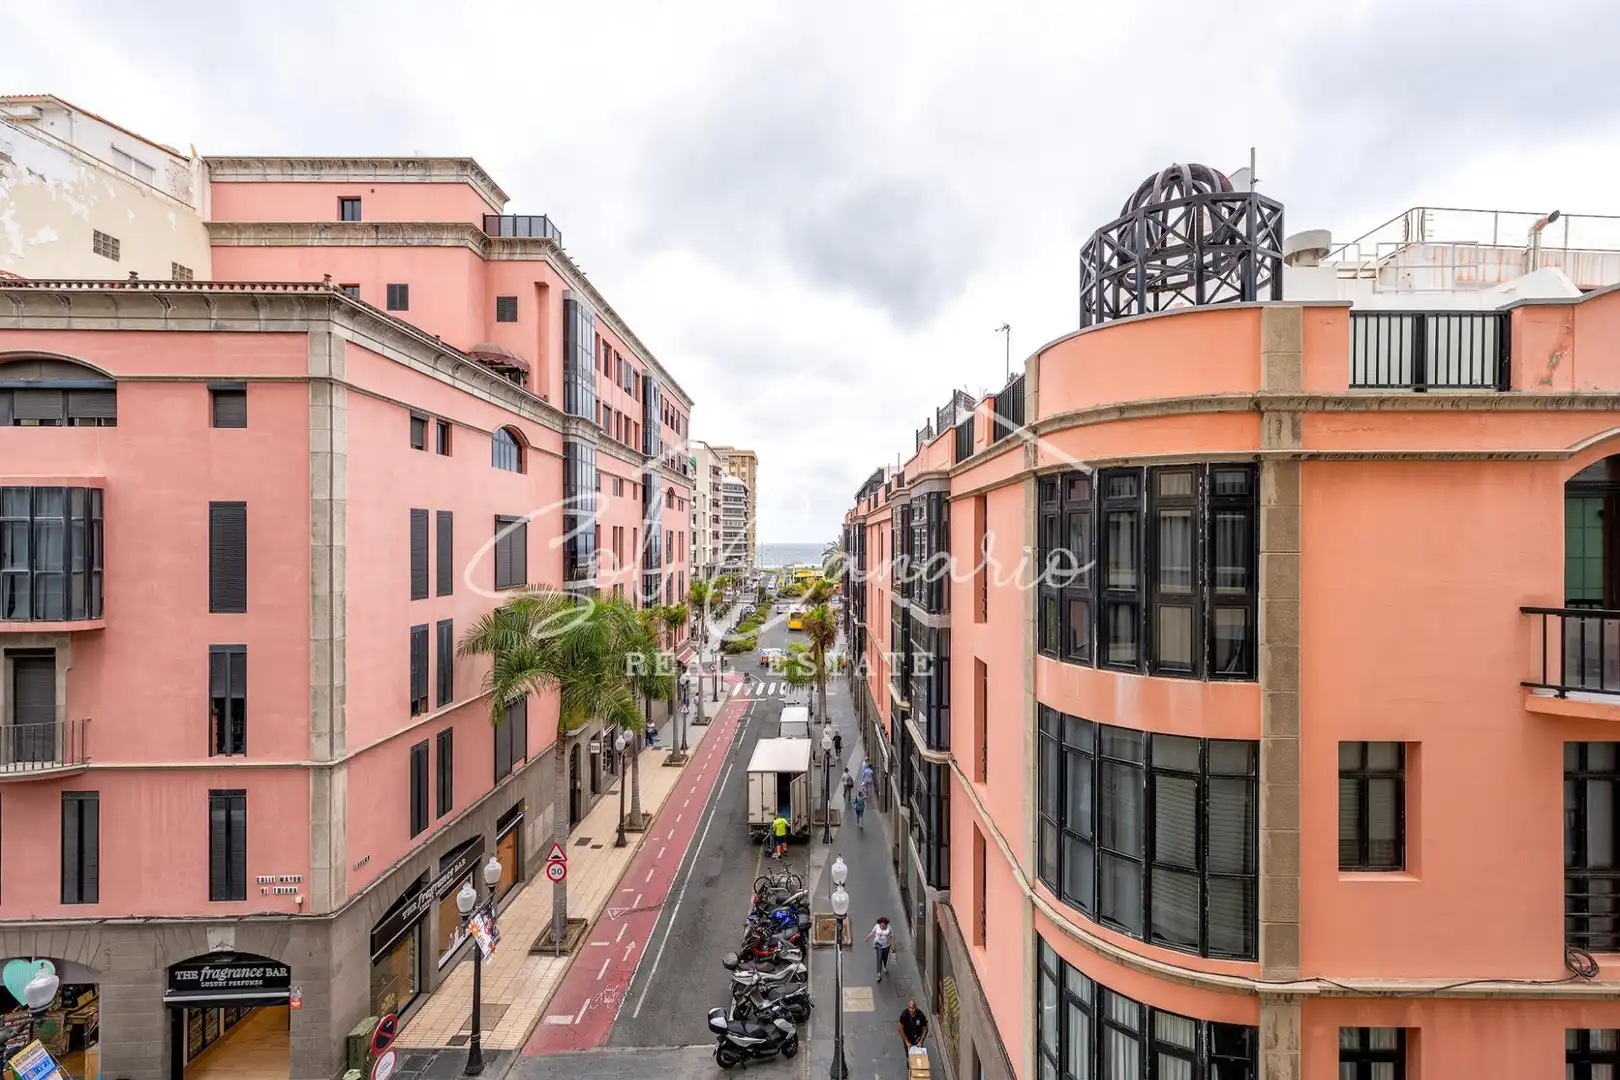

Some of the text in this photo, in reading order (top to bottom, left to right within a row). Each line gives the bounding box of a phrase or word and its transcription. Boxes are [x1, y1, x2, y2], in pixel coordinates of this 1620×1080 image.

[551, 868, 563, 876] 30
[175, 966, 288, 981] THE fragrance BAR
